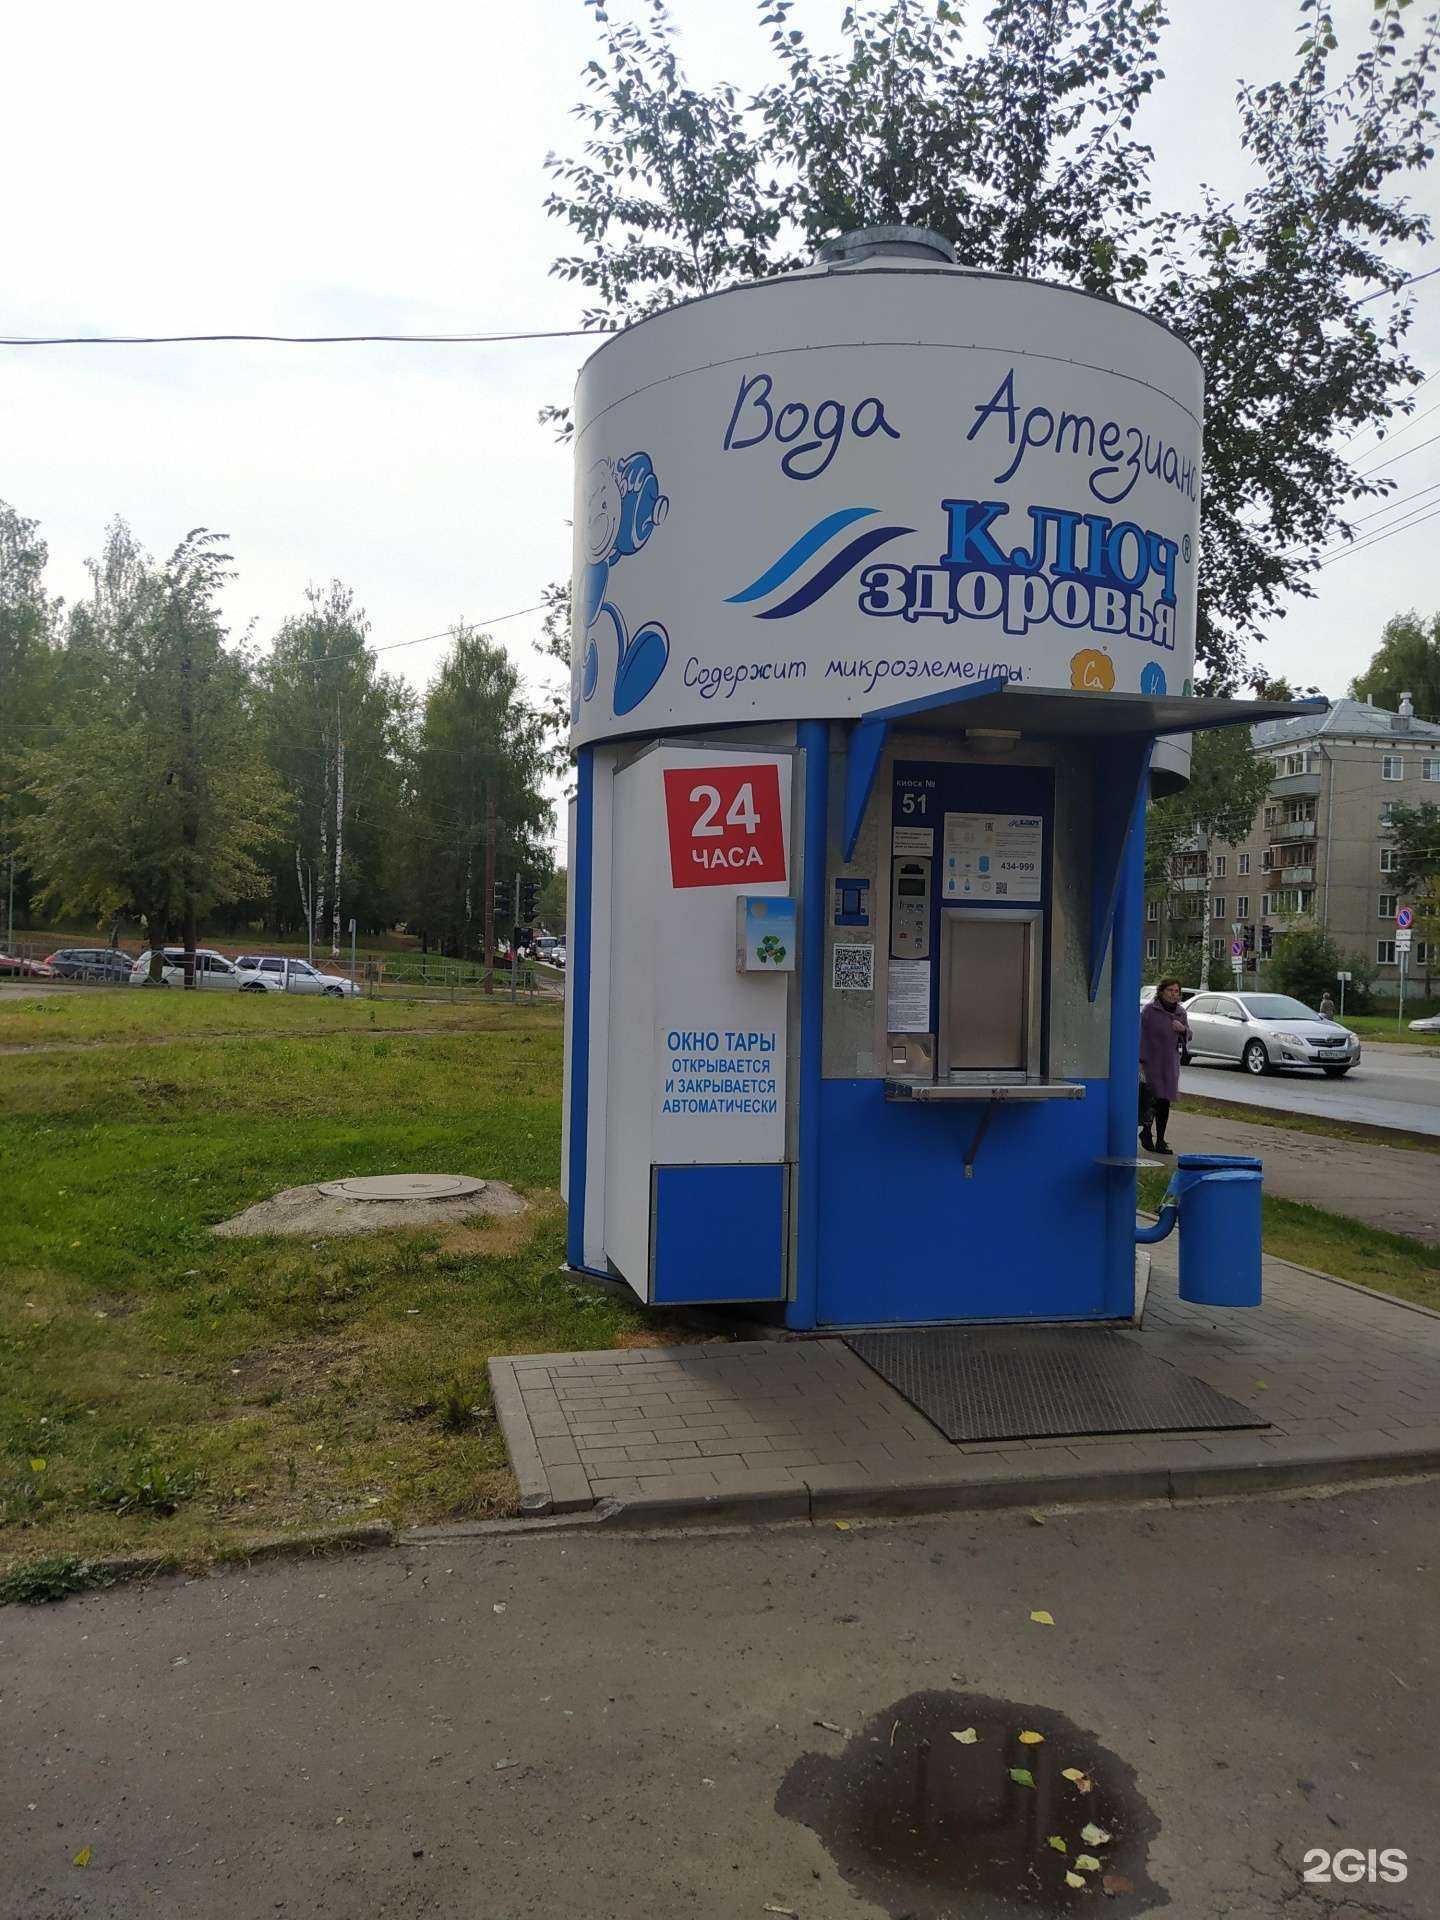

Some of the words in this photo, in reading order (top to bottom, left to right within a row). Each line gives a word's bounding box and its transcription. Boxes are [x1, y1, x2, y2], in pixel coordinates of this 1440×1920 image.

[723, 373, 901, 481] Вода
[683, 656, 808, 699] Содержит
[687, 783, 761, 838] 24
[902, 793, 927, 814] 51
[691, 846, 765, 869] ЧАСА
[1001, 861, 1035, 872] 434-999
[667, 1031, 719, 1051] ОКНО
[724, 1031, 776, 1052] ТАРЫ
[672, 1059, 770, 1073] ОТКРЫВАЕТСЯ
[665, 1080, 674, 1093] И
[678, 1080, 776, 1094] ЗАКРЫВАЕТСЯ
[662, 1099, 777, 1114] АВТОМАТИЧЕСКИ
